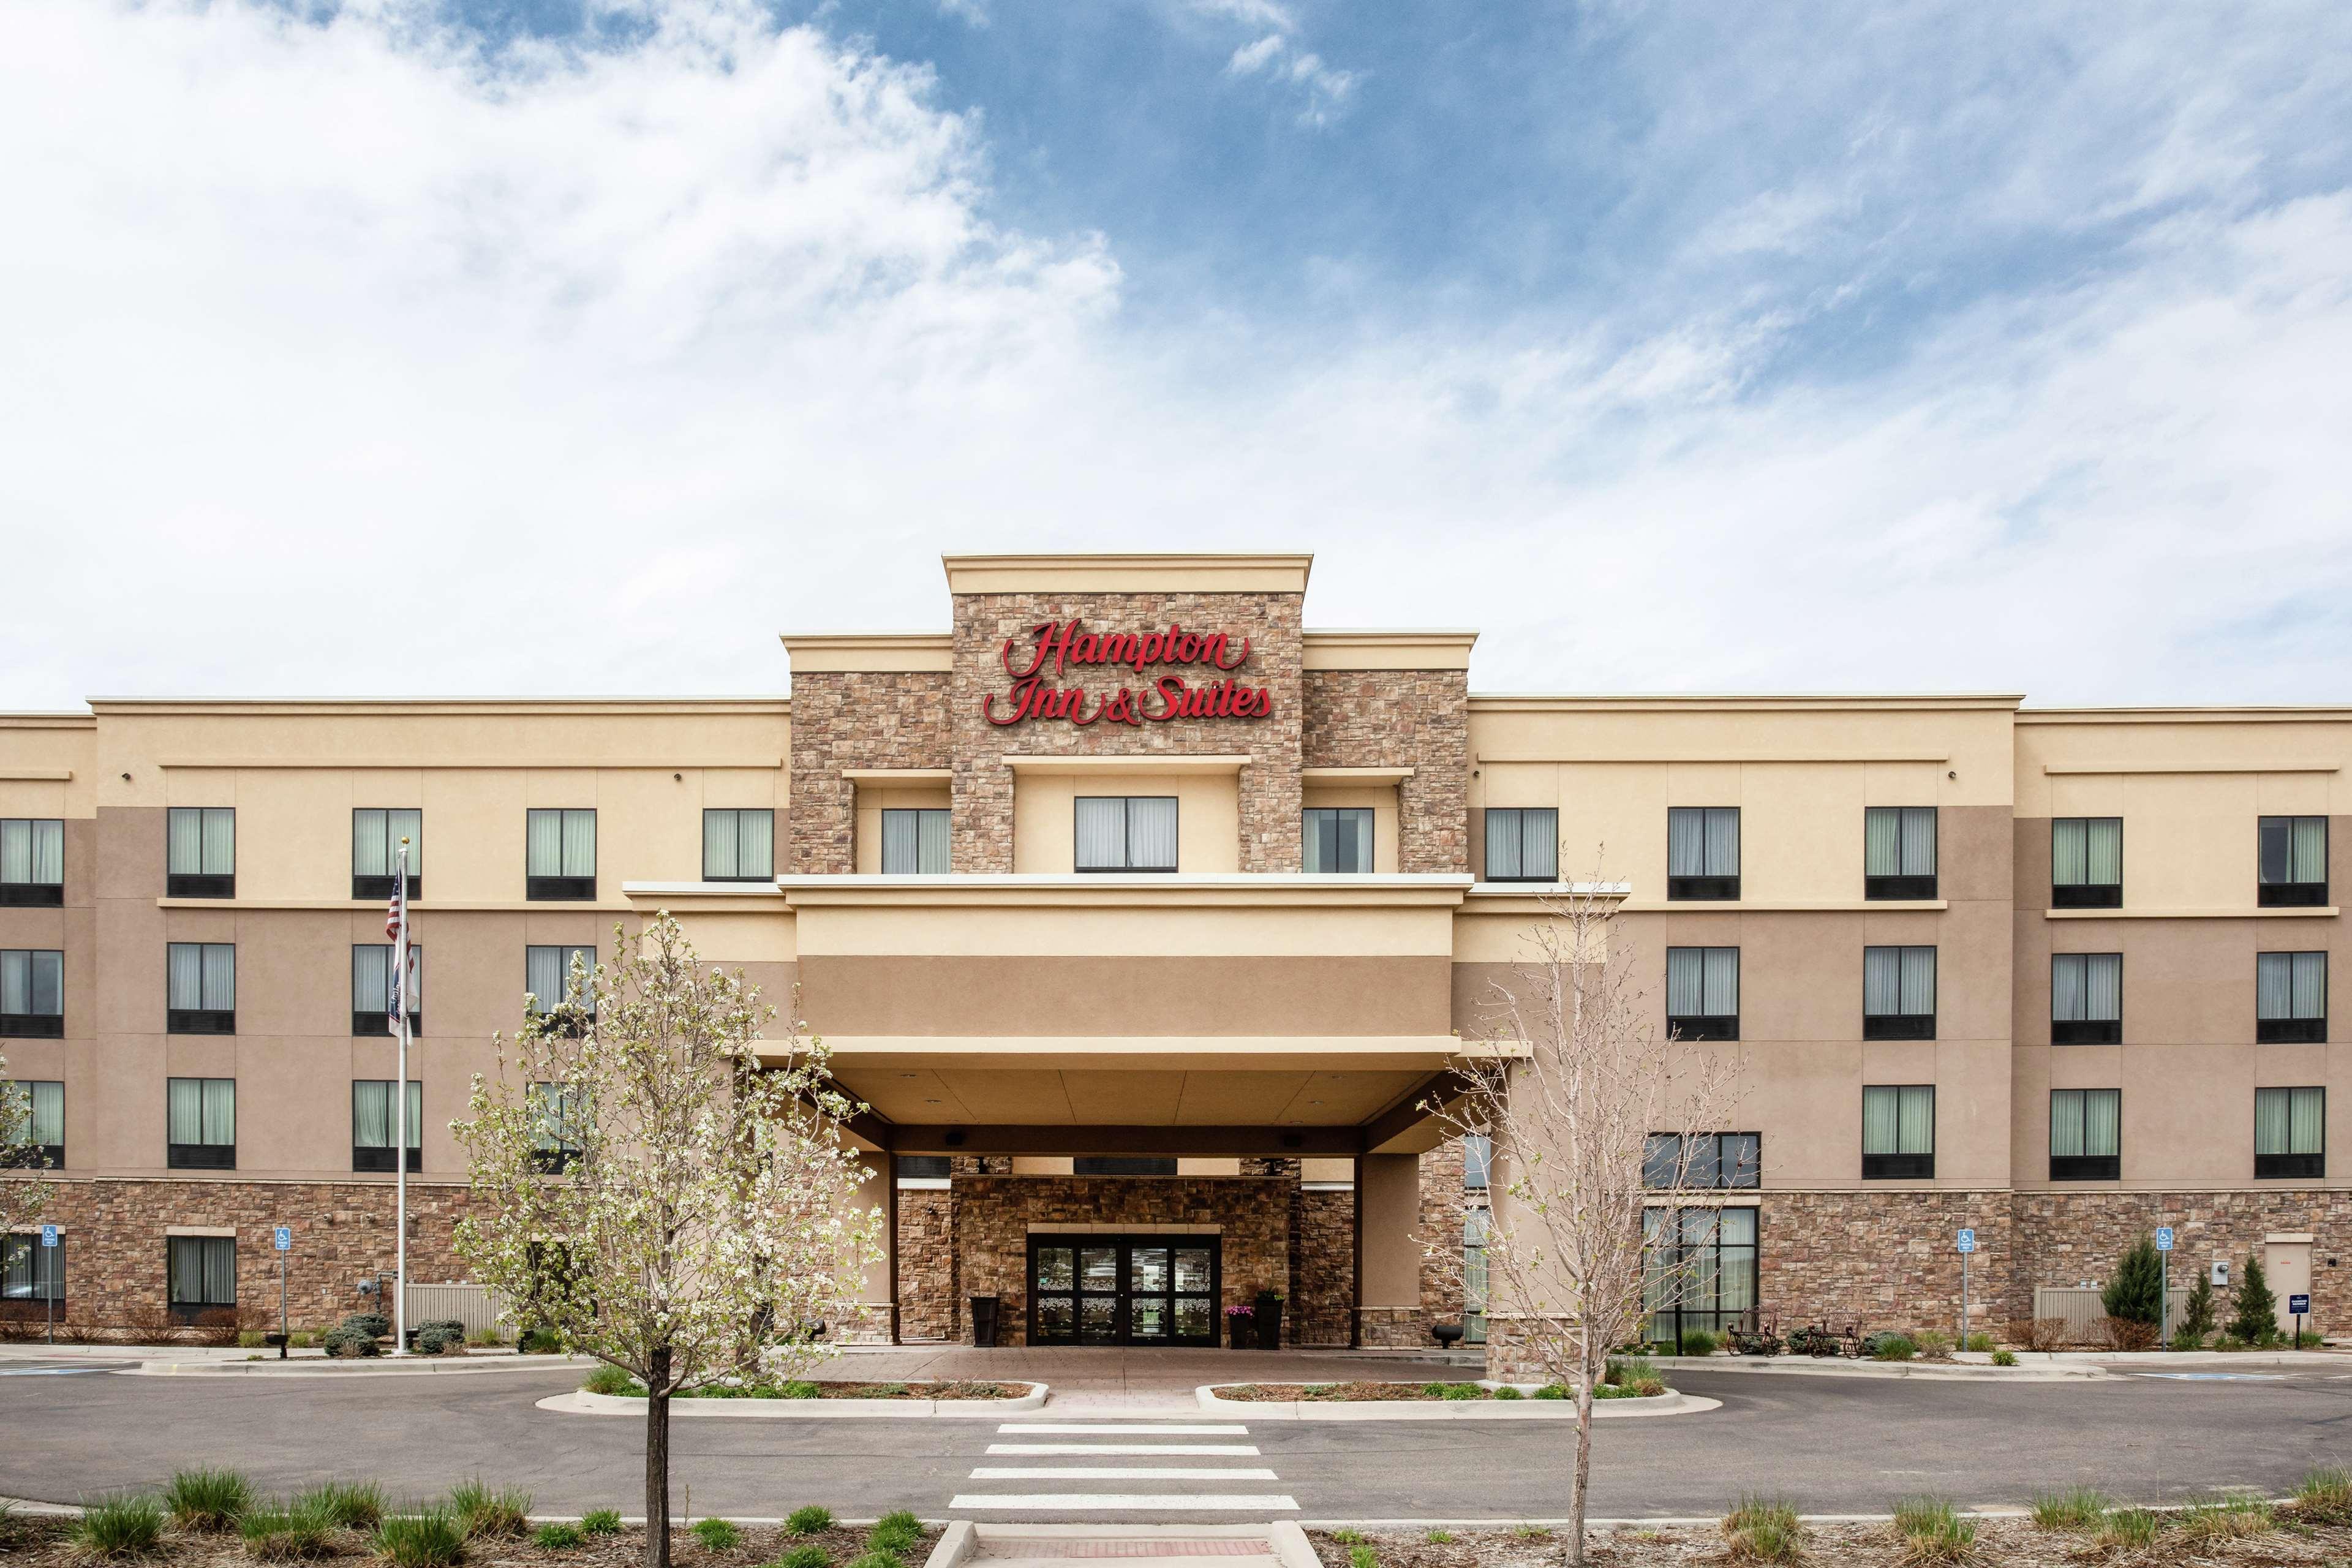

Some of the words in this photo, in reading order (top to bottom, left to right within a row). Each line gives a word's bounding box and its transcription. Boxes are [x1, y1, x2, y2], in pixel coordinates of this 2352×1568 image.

[1003, 618, 1249, 677] Hampton
[984, 676, 1106, 725] Inn
[1106, 687, 1142, 726] &
[1138, 676, 1272, 721] Suites
